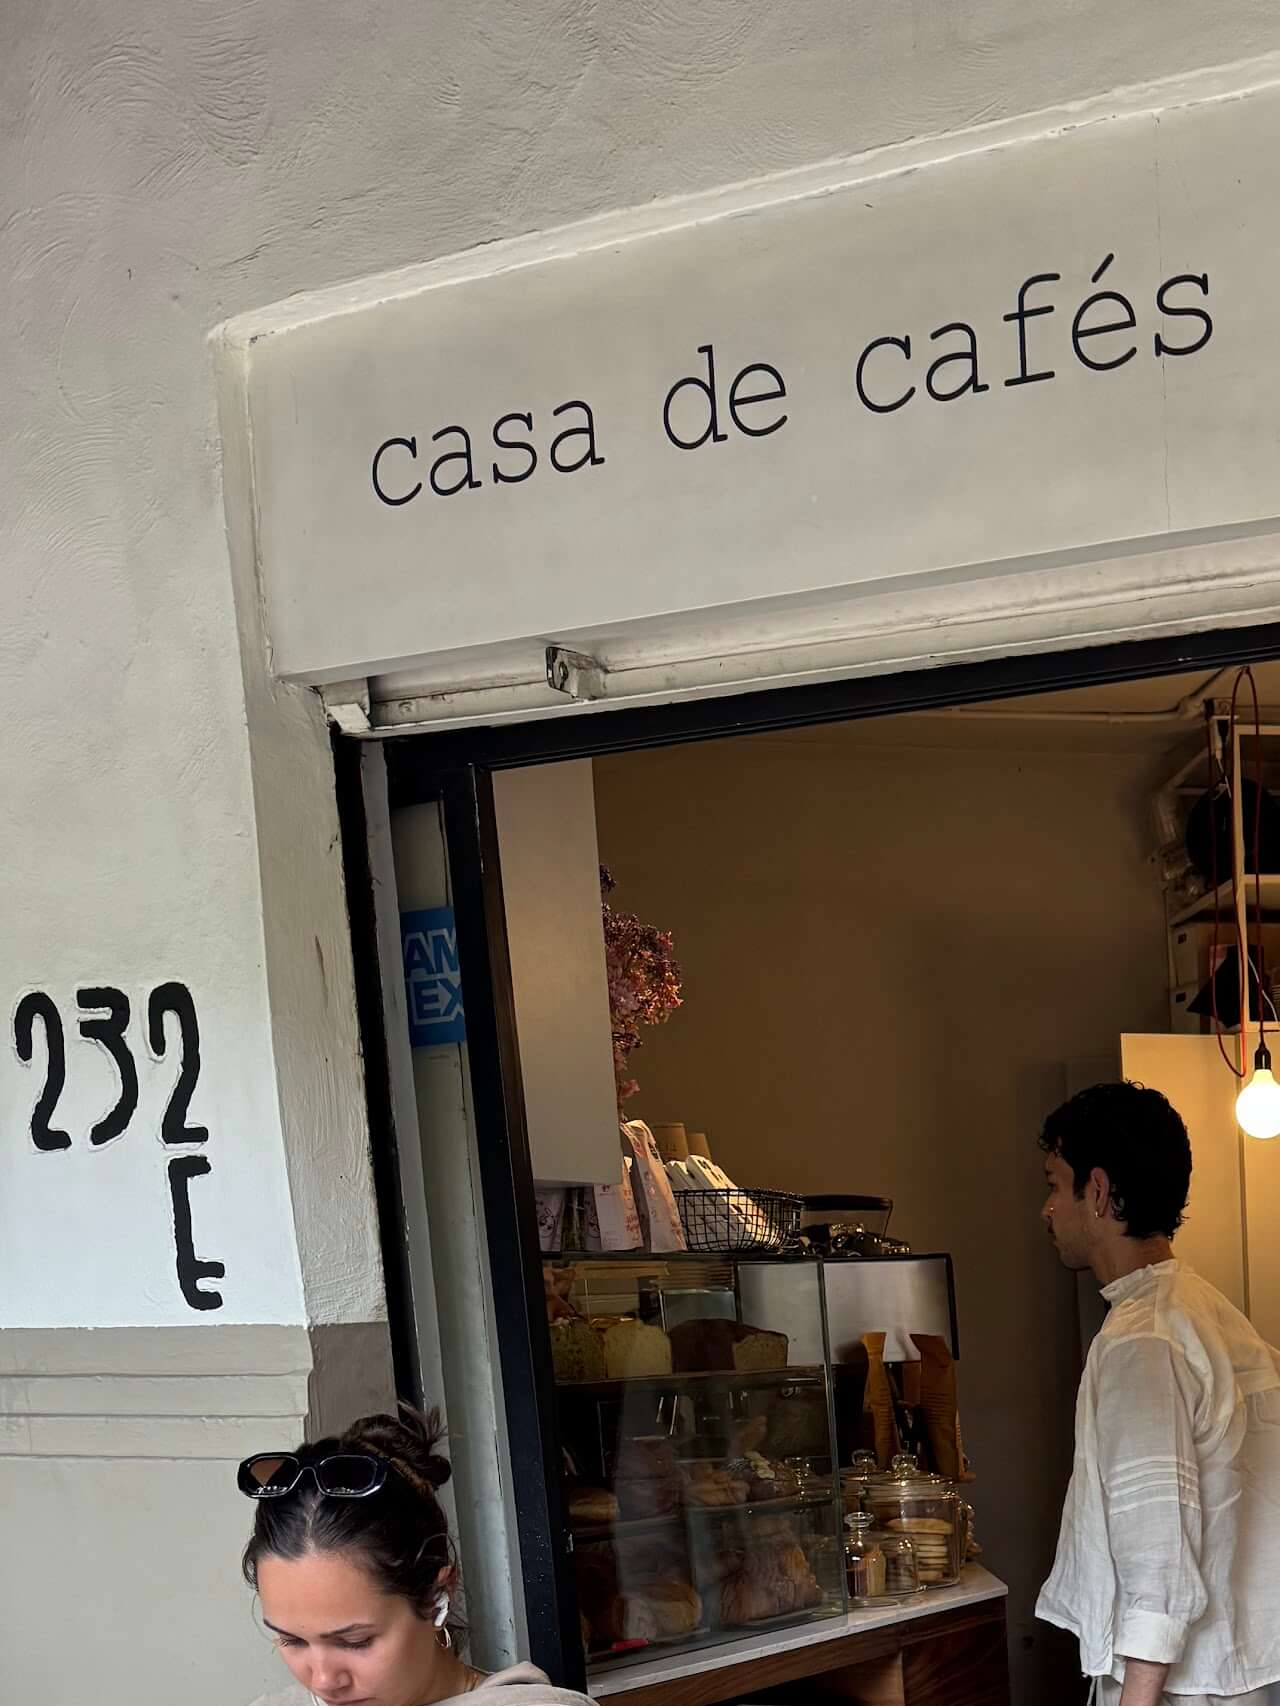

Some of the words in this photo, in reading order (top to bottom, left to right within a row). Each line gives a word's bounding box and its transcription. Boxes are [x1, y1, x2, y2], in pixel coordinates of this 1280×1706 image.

[372, 400, 605, 506] casa
[663, 344, 788, 450] de
[855, 252, 1213, 414] cafés
[13, 981, 209, 1152] 232
